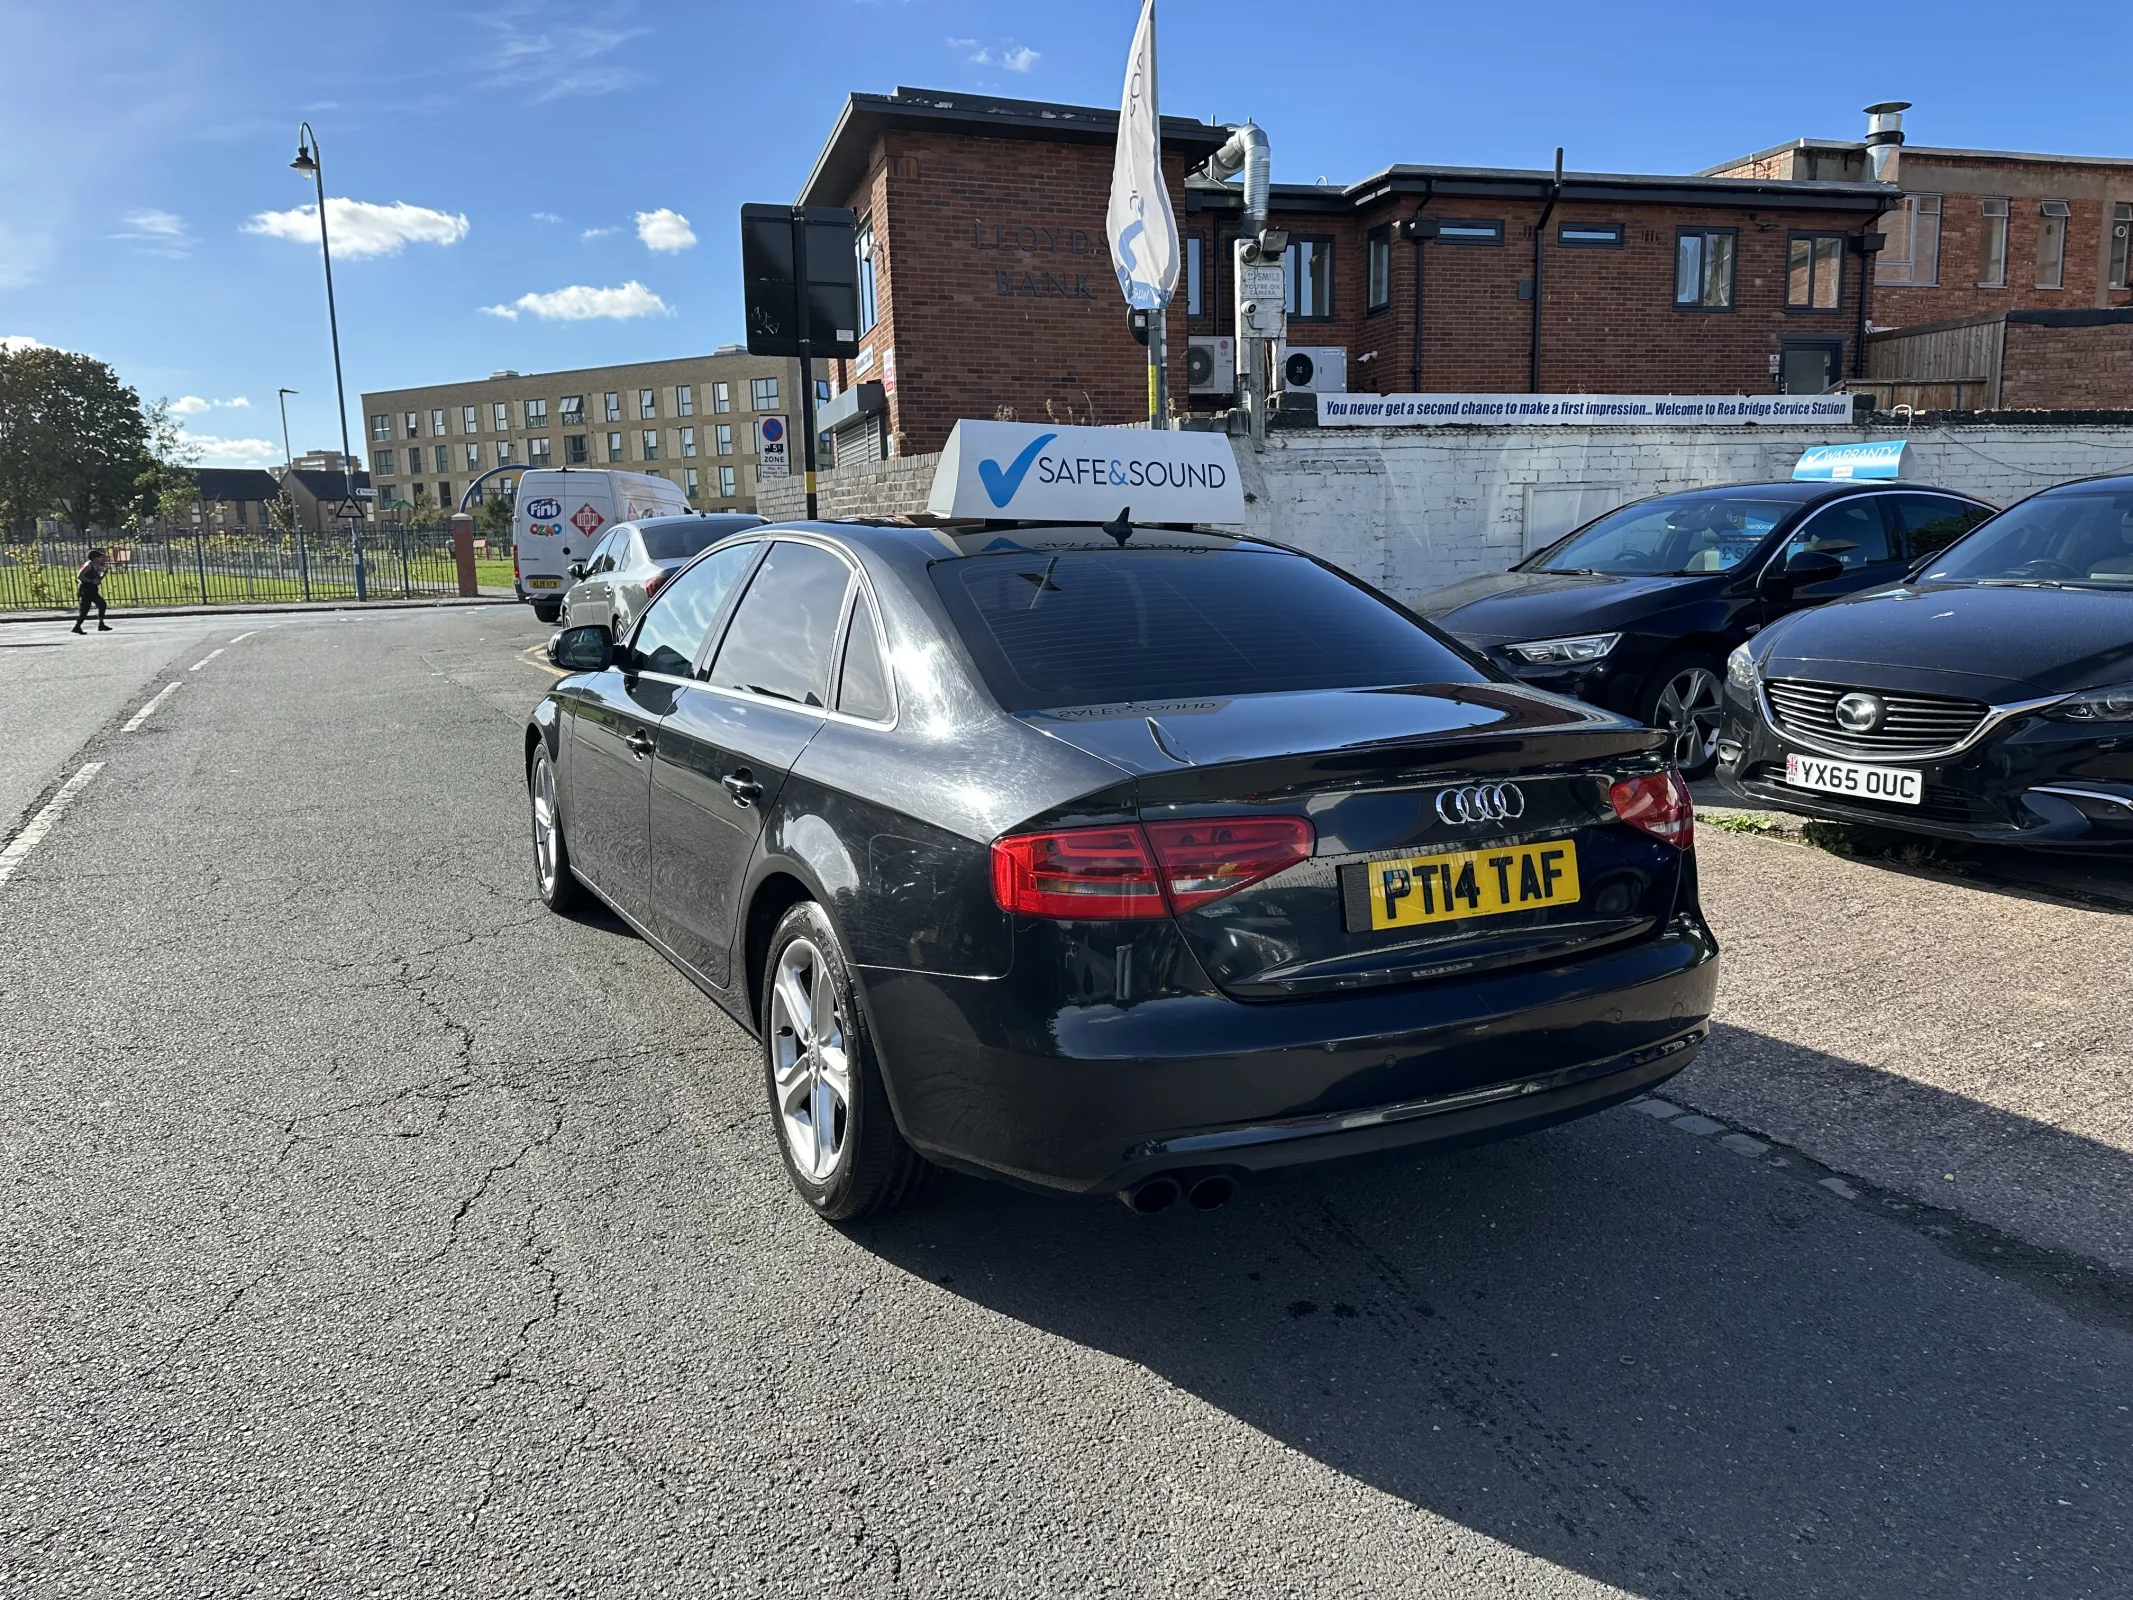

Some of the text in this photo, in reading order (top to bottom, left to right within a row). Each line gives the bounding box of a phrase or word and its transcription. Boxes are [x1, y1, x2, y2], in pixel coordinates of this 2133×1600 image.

[995, 269, 1098, 299] BANK
[1257, 272, 1281, 281] SMILE
[1326, 401, 1348, 415] You
[1349, 403, 1383, 415] never
[1385, 401, 1405, 417] get
[1407, 403, 1414, 415] a
[1416, 401, 1459, 415] second
[1461, 401, 1503, 415] chance
[1505, 401, 1518, 415] to
[1519, 401, 1549, 415] make
[1551, 403, 1559, 415] a
[1560, 401, 1586, 415] first
[1655, 402, 1703, 415] Welcome
[1705, 402, 1716, 415] to
[1717, 402, 1736, 415] Rea
[1738, 402, 1771, 417] Bridge
[1773, 402, 1810, 415] Service
[1811, 401, 1846, 415] Station
[1823, 446, 1898, 461] WARRANTY
[1039, 456, 1226, 489] SAFE&SOUND
[530, 500, 558, 518] Fini
[1801, 760, 1916, 799] YX65 OUC
[1382, 850, 1564, 920] PT14 TAF
